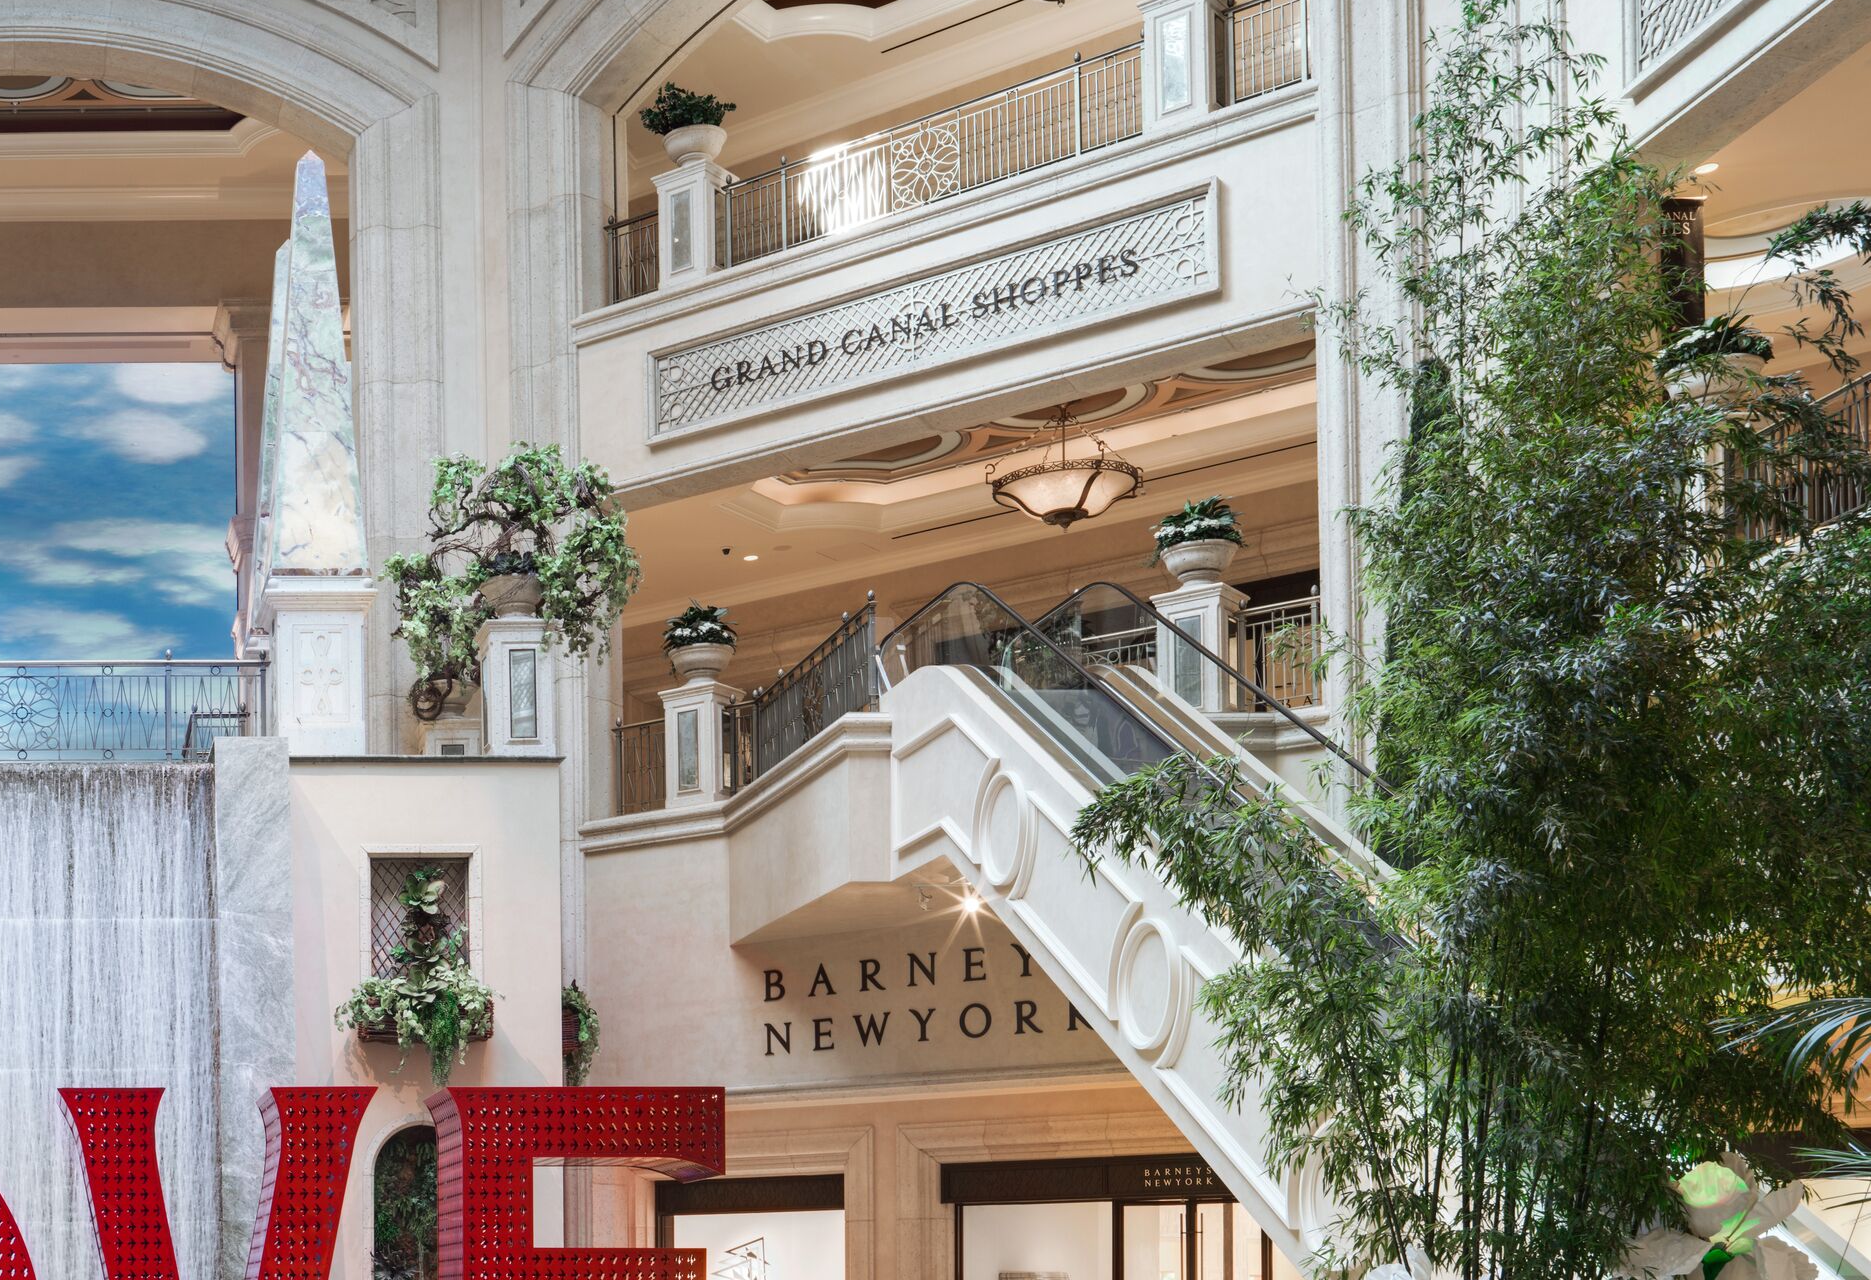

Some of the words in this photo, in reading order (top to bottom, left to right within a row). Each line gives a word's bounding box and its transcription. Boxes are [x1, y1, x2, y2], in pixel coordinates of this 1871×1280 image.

[1661, 211, 1696, 221] ANAL
[710, 339, 829, 393] GRAND
[840, 301, 960, 356] CANAL
[972, 248, 1139, 319] SHOPPES
[763, 943, 1032, 1002] BARNEY
[1144, 1167, 1212, 1177] BARNEYS
